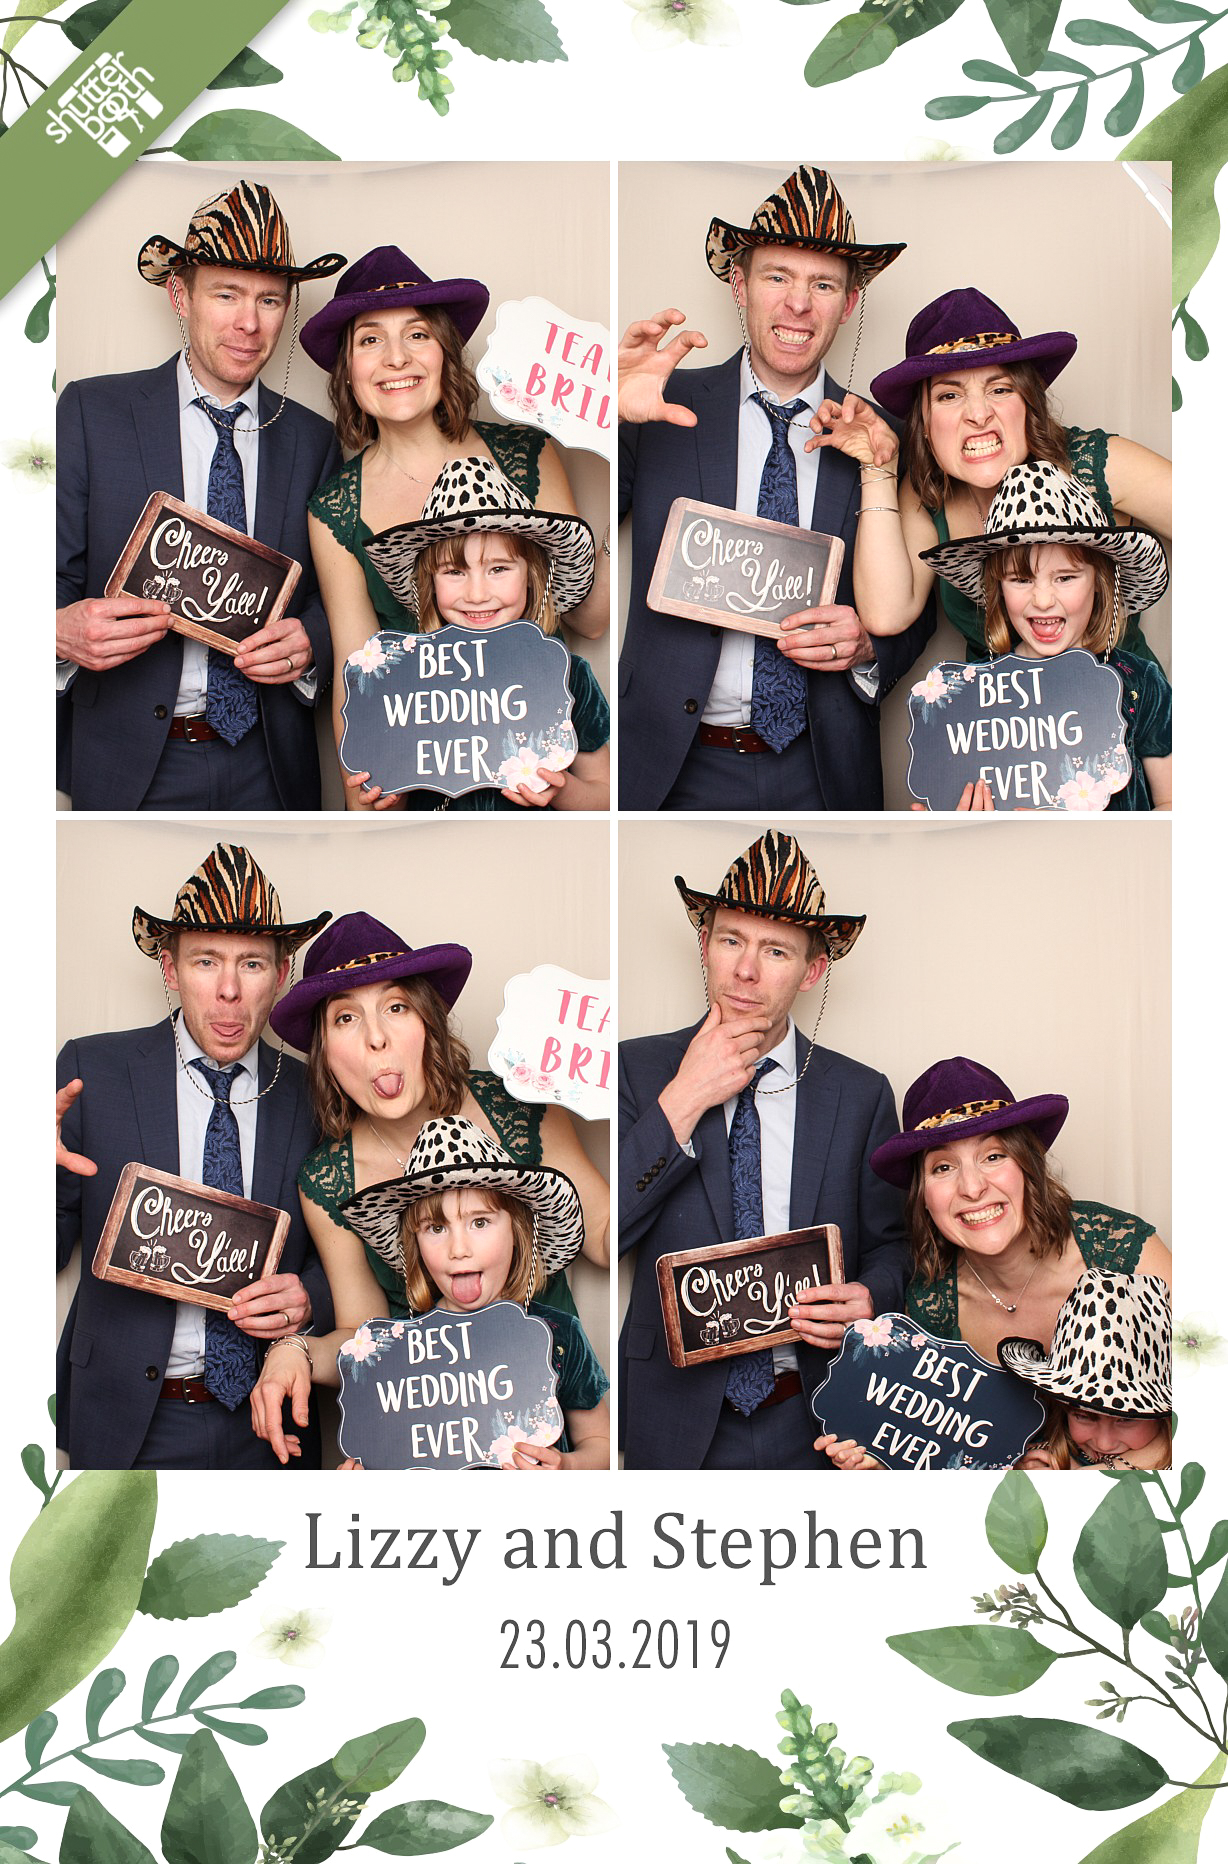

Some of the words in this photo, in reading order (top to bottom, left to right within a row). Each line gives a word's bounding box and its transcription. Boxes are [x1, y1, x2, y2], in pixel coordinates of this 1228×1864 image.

[545, 321, 610, 383] TEA
[150, 517, 229, 570] Cheers
[681, 518, 764, 570] Cheers
[181, 566, 269, 625] Y'all!
[725, 557, 814, 614] Y'all!
[419, 639, 488, 681] BEST
[383, 684, 528, 727] WEDDING
[979, 667, 1044, 709] BEST
[417, 735, 494, 782] EVER
[946, 710, 1083, 755] WEDDING
[130, 1186, 213, 1240] Cheers
[170, 1228, 259, 1285] Y'all!
[681, 1263, 763, 1317] Cheers
[408, 1321, 473, 1365] BEST
[376, 1364, 514, 1413] WEDDING
[912, 1347, 988, 1402] BEST
[866, 1372, 994, 1448] WEDDING
[411, 1416, 485, 1462] EVER
[871, 1421, 941, 1470] EVER
